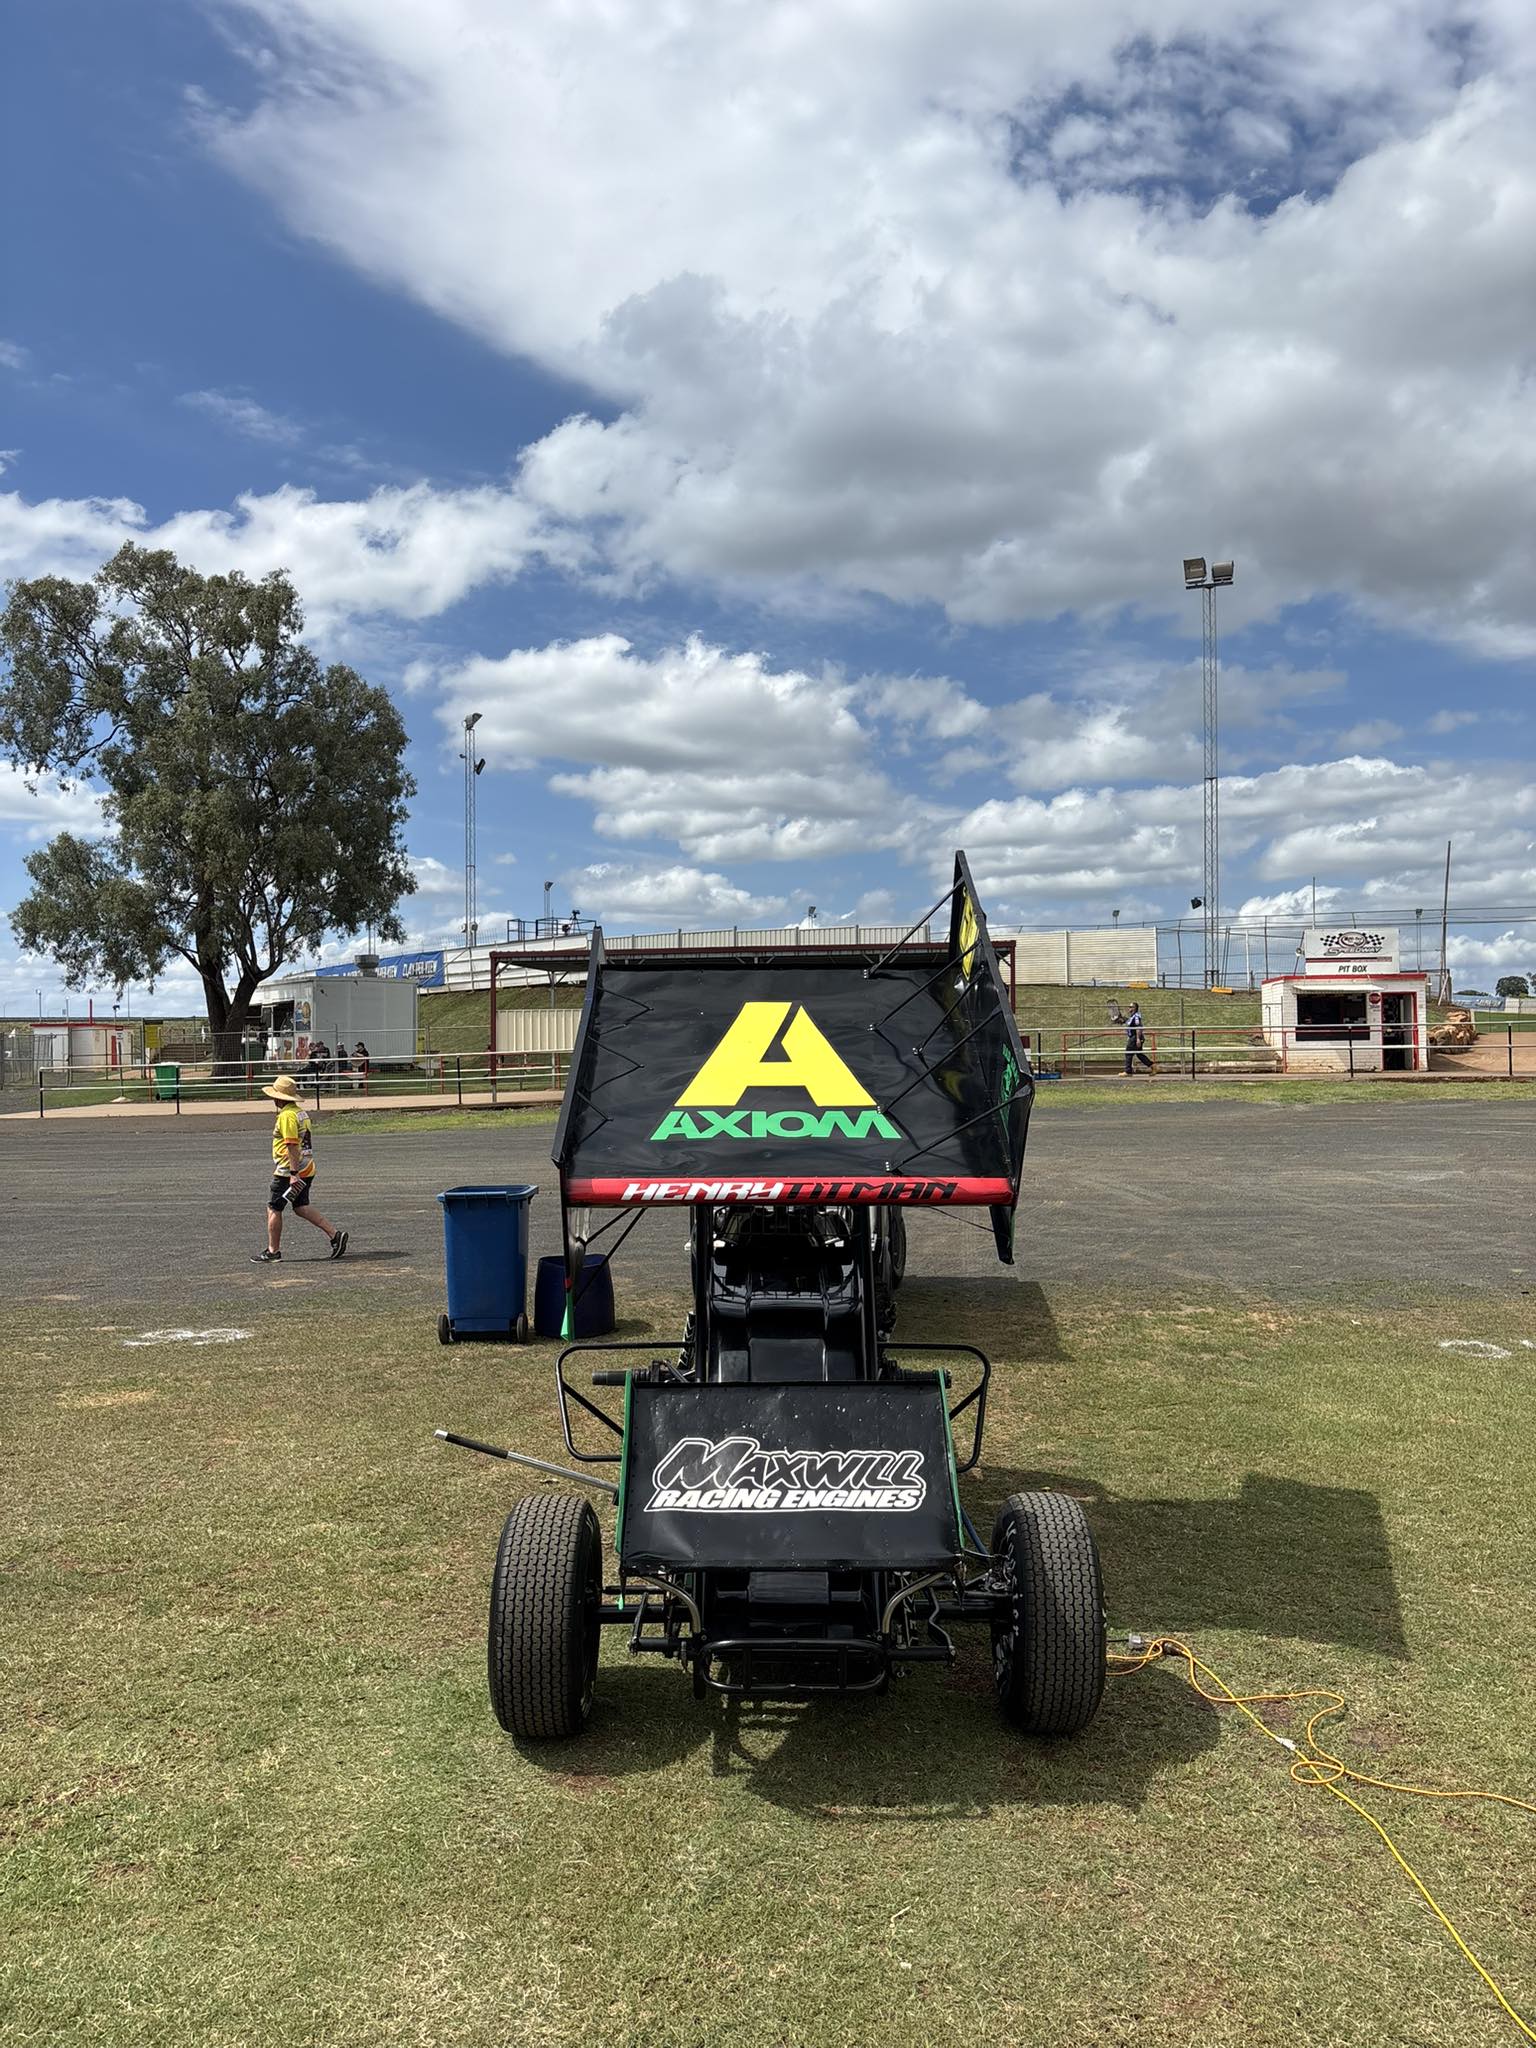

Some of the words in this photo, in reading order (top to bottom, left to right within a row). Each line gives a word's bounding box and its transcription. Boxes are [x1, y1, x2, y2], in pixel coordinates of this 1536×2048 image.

[1338, 965, 1351, 973] PIT
[1352, 965, 1368, 973] BOX
[650, 1110, 903, 1140] AXIOM
[621, 1182, 784, 1200] HENRY
[784, 1182, 959, 1200] TITMAN
[653, 1437, 926, 1491] MAXWILL
[652, 1488, 782, 1509] RACING
[787, 1489, 919, 1508] ENGINES
